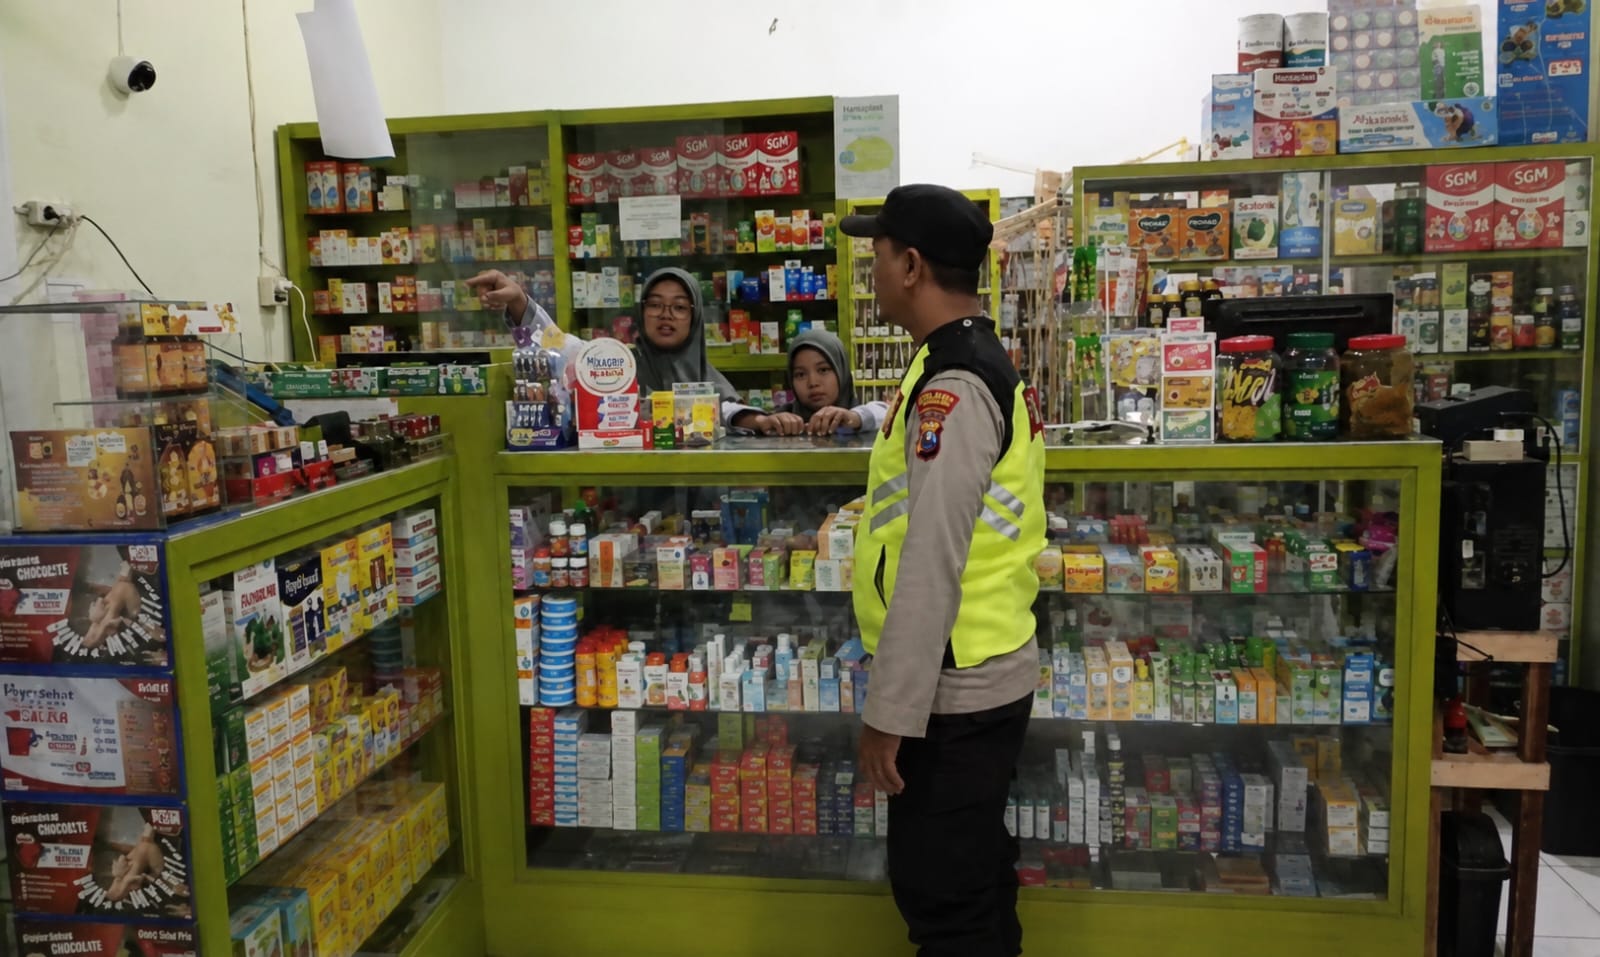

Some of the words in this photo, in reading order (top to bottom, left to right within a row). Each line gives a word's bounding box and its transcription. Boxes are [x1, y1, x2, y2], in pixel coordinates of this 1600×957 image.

[686, 139, 708, 153] SGM
[726, 137, 748, 152] SGM
[766, 135, 789, 150] SGM
[577, 156, 595, 167] SGM
[651, 150, 670, 162] SGM
[1445, 170, 1477, 188] SGM
[1514, 166, 1548, 185] SGM
